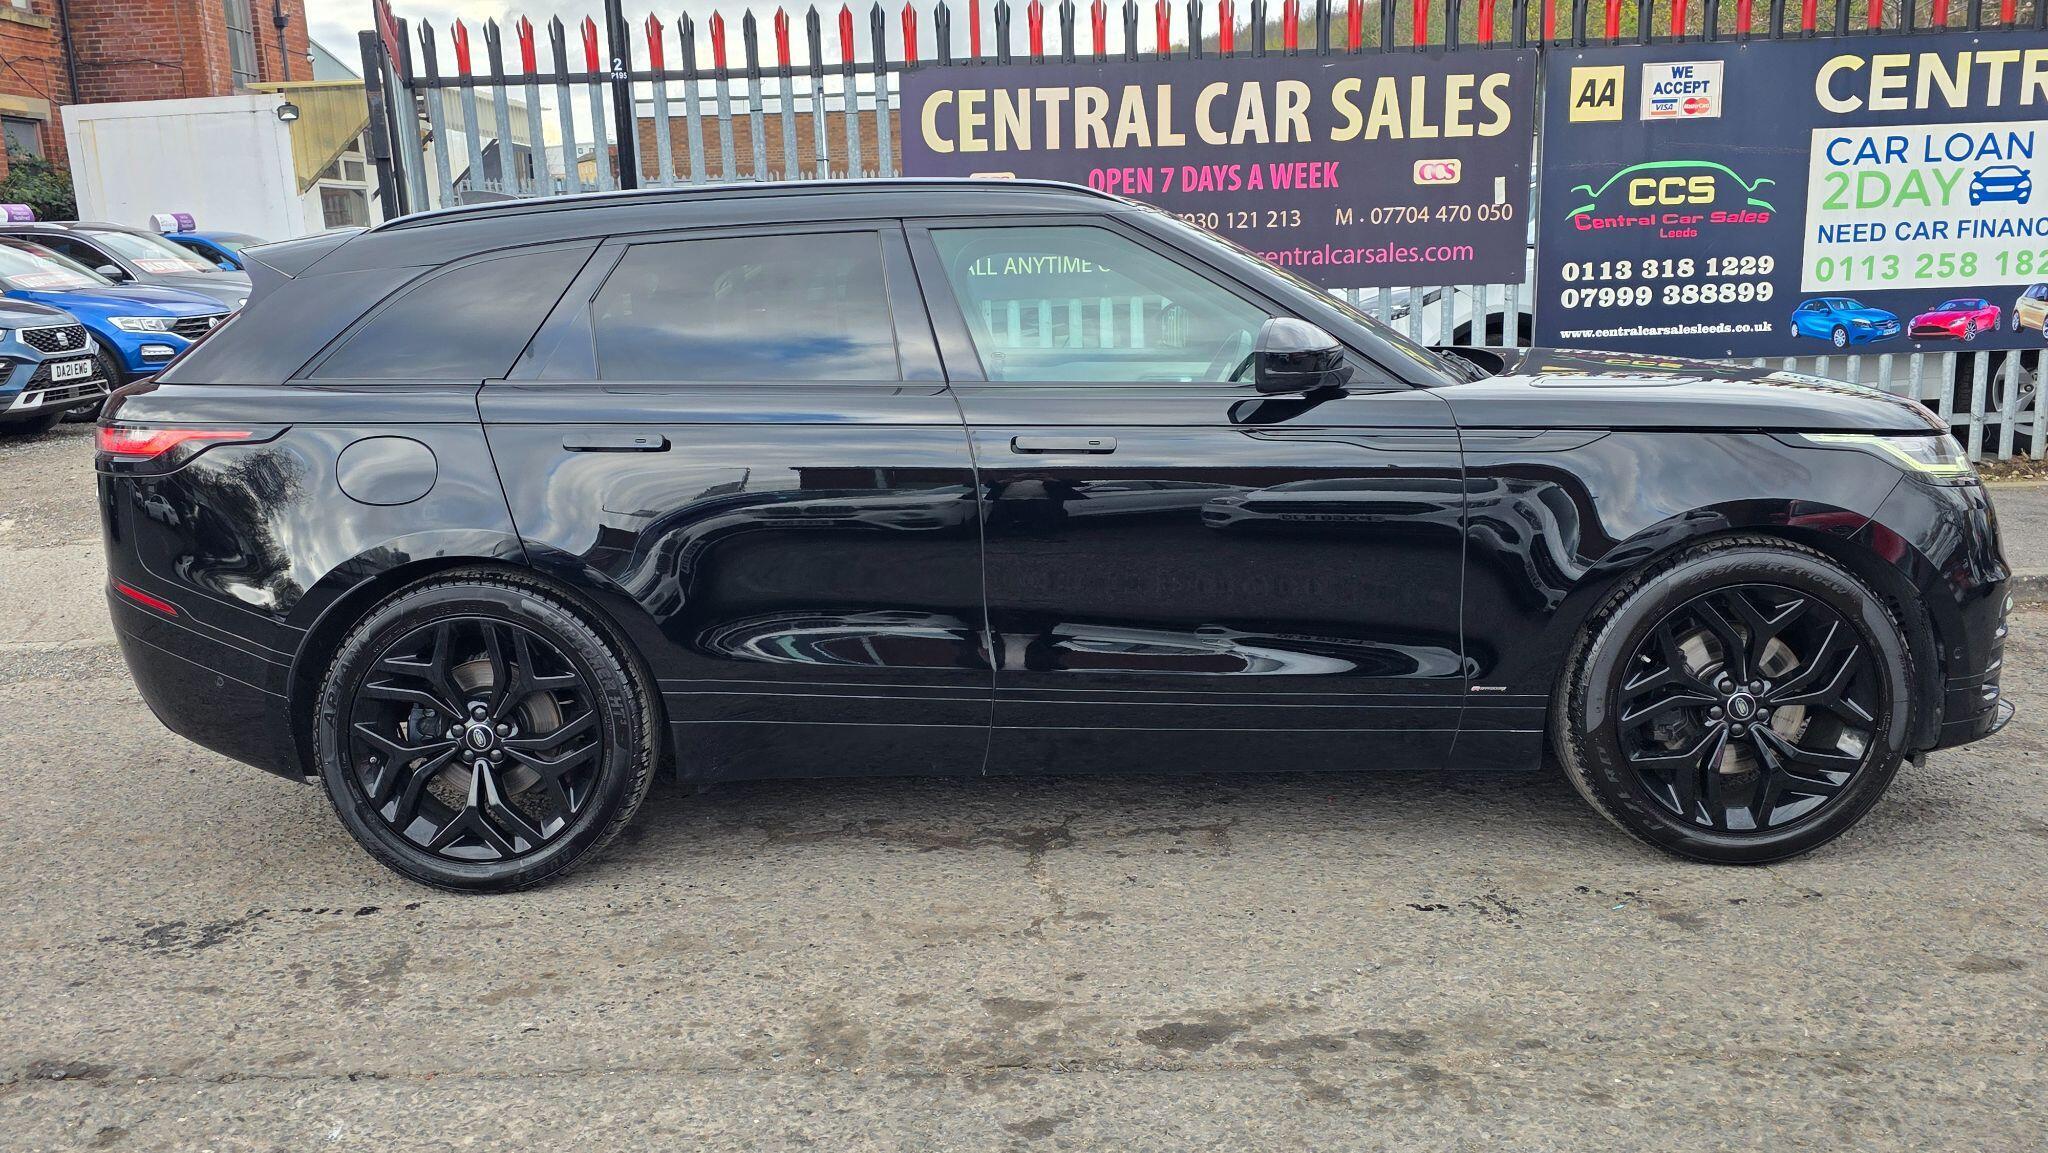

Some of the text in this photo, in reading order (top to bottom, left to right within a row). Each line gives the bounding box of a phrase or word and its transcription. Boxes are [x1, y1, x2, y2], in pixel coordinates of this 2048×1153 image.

[613, 58, 622, 71] 2
[1671, 66, 1693, 79] WE
[1576, 79, 1616, 108] AA
[1653, 81, 1710, 95] ACCEPT
[1815, 49, 2048, 114] CENTR
[921, 72, 1512, 153] CENTRAL CAR SALES
[1655, 103, 1674, 111] VISA
[1826, 131, 2035, 166] CAR LOAN
[1088, 161, 1340, 194] OPEN 7 DAYS A WEEK
[1418, 163, 1456, 180] CCS
[1628, 175, 1716, 206] CCS
[1822, 168, 1965, 210] 2DAY
[1226, 211, 1257, 228] 121
[1267, 209, 1301, 228] 213
[1335, 208, 1353, 225] M
[1370, 206, 1430, 225] 07704
[1435, 205, 1472, 222] 470
[1478, 204, 1513, 221] 050
[1574, 209, 1770, 231] Central Car Sales
[1659, 227, 1698, 238] Leeds
[1817, 222, 1886, 244] NEED
[1895, 220, 1949, 241] CAR
[1004, 256, 1093, 275] ANYTIME
[1561, 255, 1775, 282] 0113 318 1229
[1815, 254, 1900, 282] 0113
[1914, 251, 1978, 280] 258
[1560, 281, 1774, 309] 07999 388899
[1559, 321, 1772, 339] www.centralcarsalesleeds.co.uk
[56, 364, 73, 378] DA21
